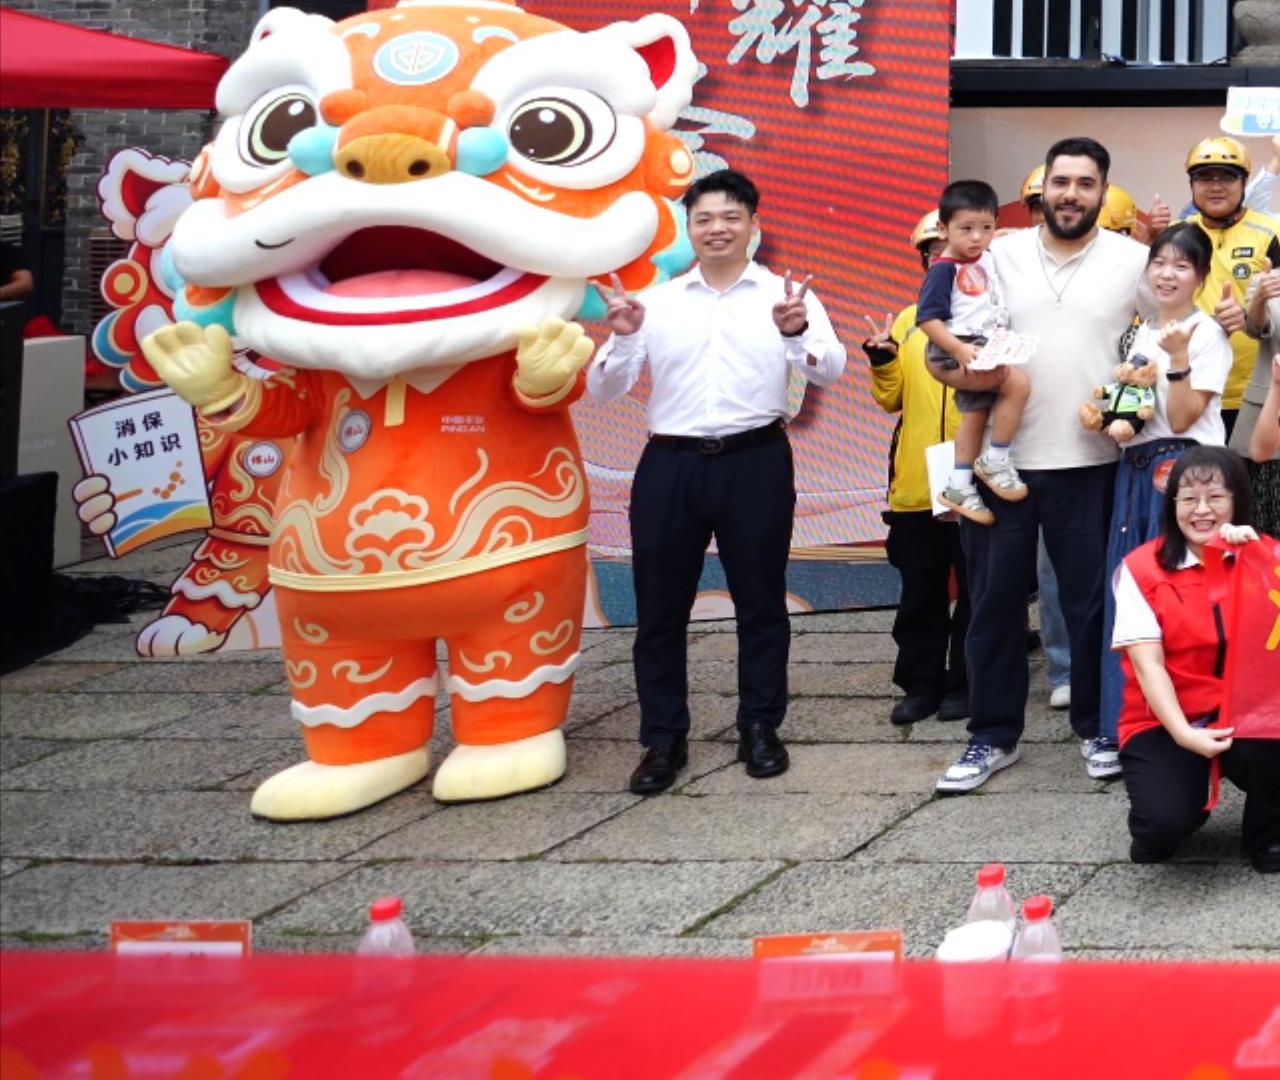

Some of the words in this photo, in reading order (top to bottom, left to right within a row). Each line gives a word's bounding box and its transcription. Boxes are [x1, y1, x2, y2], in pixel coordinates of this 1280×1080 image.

[114, 410, 165, 439] 消保
[107, 432, 183, 467] 小知识
